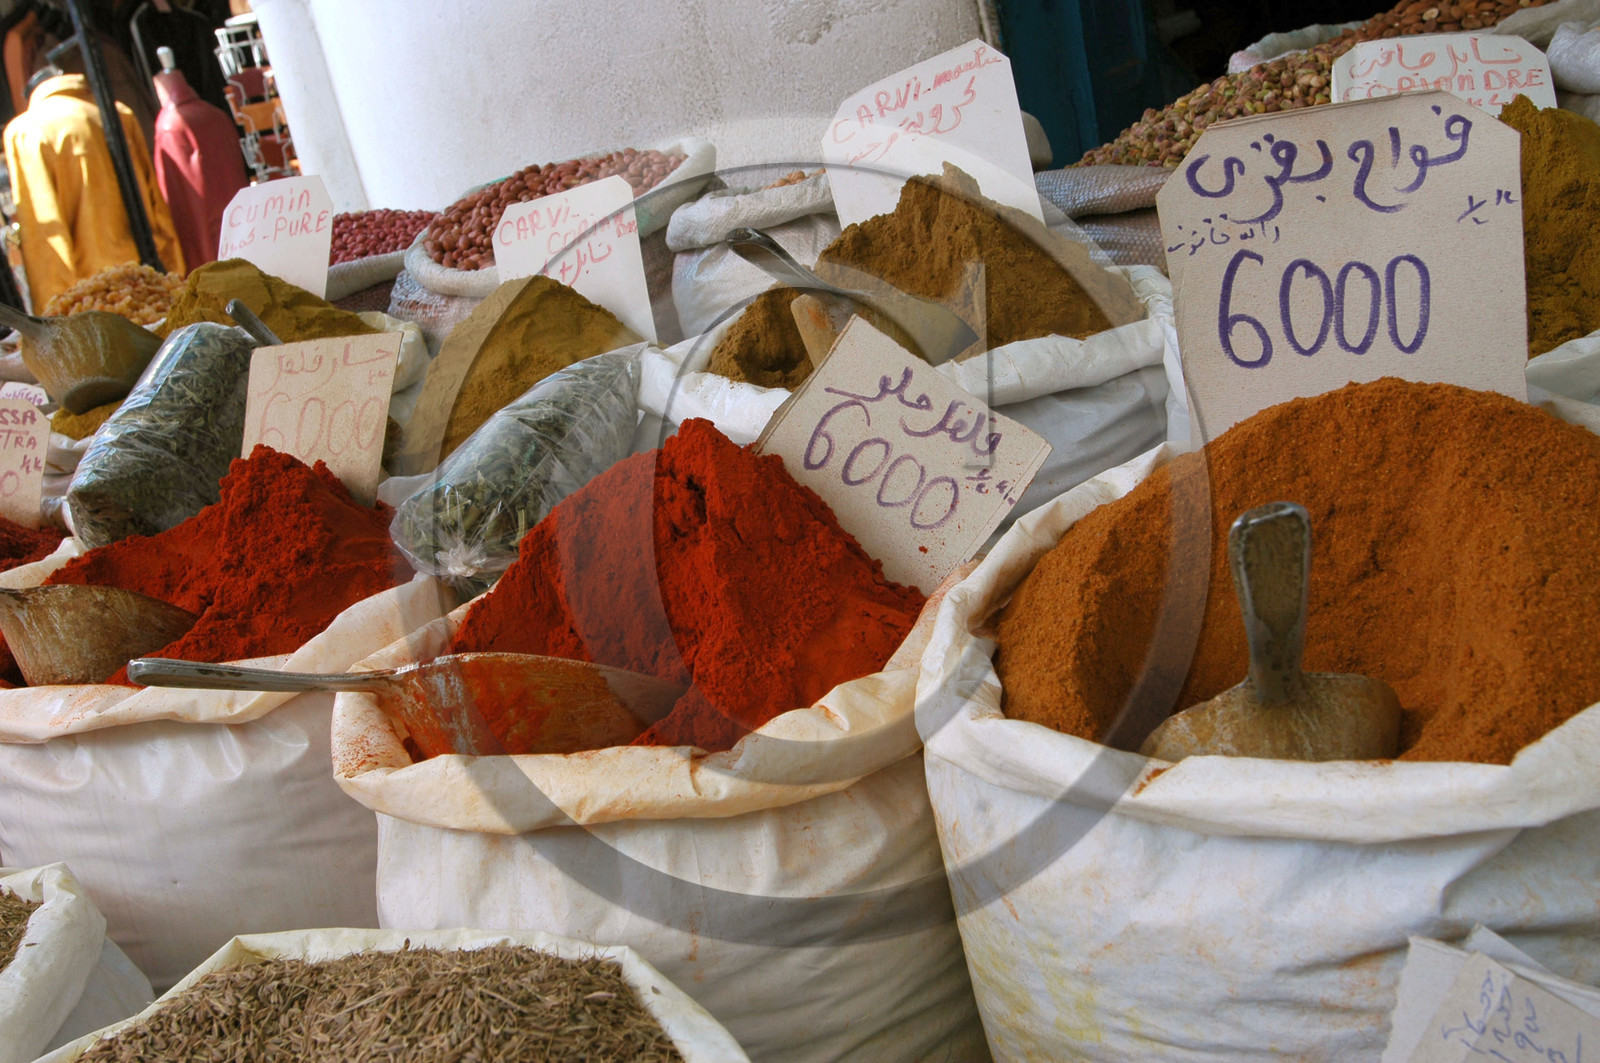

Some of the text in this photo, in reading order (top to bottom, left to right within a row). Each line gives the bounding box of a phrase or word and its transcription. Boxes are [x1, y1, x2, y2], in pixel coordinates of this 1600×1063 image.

[1217, 248, 1431, 369] 6000
[257, 391, 385, 461] 6000
[803, 399, 960, 530] 6000
